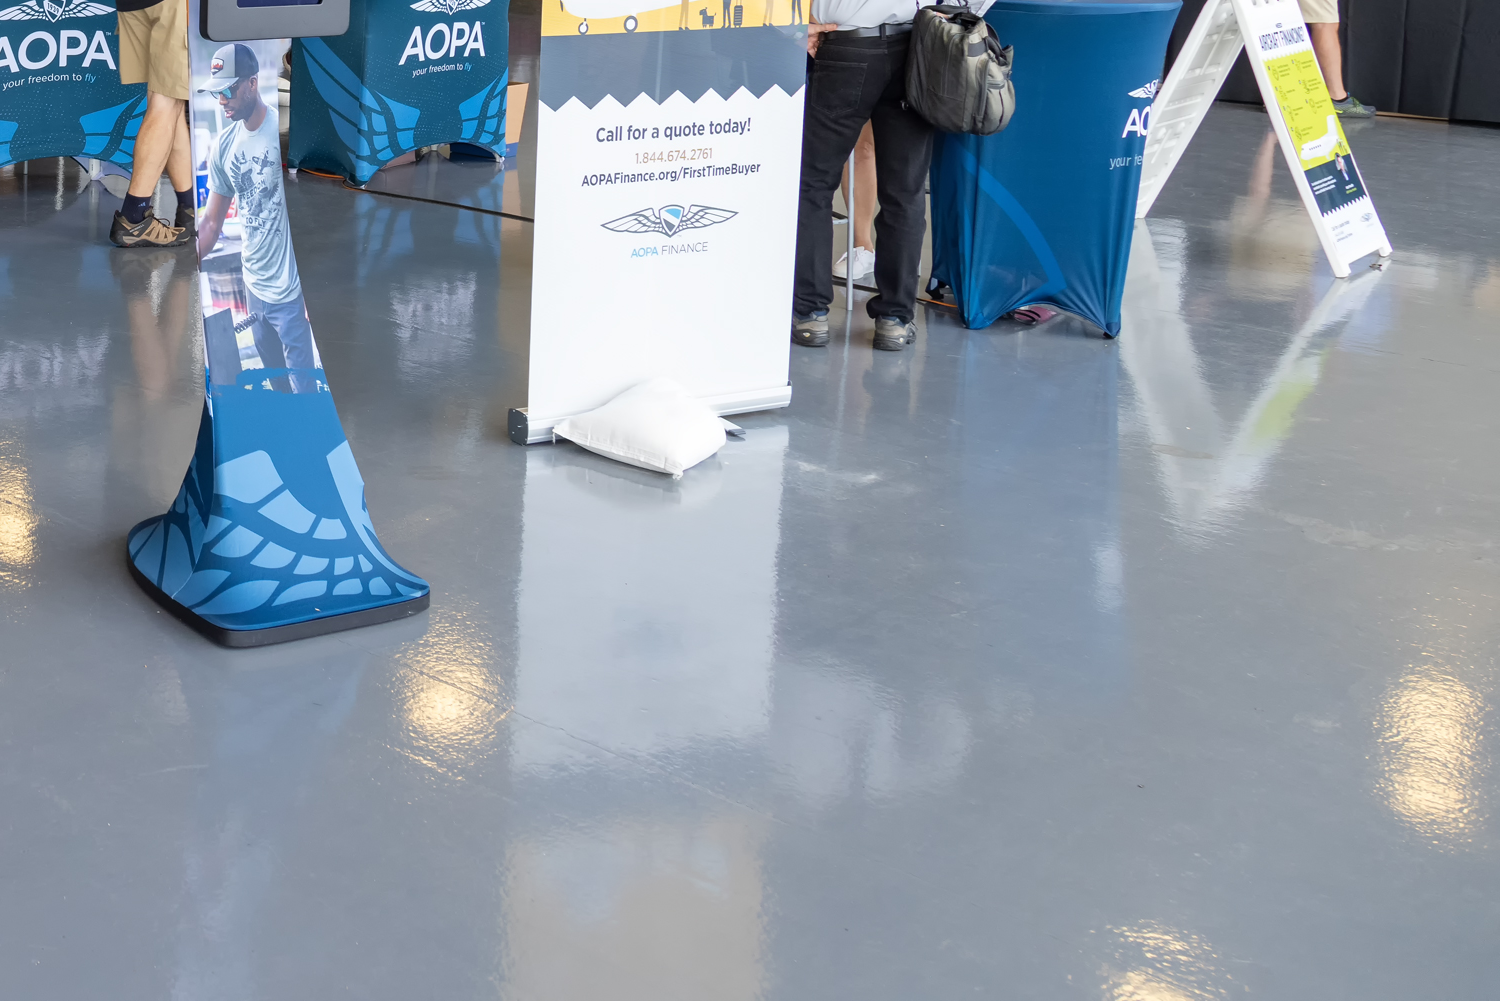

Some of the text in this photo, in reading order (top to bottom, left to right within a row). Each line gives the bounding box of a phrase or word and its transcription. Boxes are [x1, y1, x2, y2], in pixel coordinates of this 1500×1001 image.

[398, 20, 486, 66] AOPA
[1258, 30, 1280, 51] AIRCRAFT
[412, 67, 427, 78] your
[428, 63, 455, 73] freedom
[464, 62, 472, 71] fly
[2, 78, 25, 91] your
[28, 73, 69, 85] freedom
[84, 73, 96, 83] fly
[596, 117, 751, 142] Call for a quote today!
[635, 148, 713, 164] 1.844.674.2761
[1109, 158, 1131, 170] your
[581, 162, 761, 187] AOPAFinance.org/FirstTimeBuyer
[630, 242, 709, 258] AOPA FINANCE
